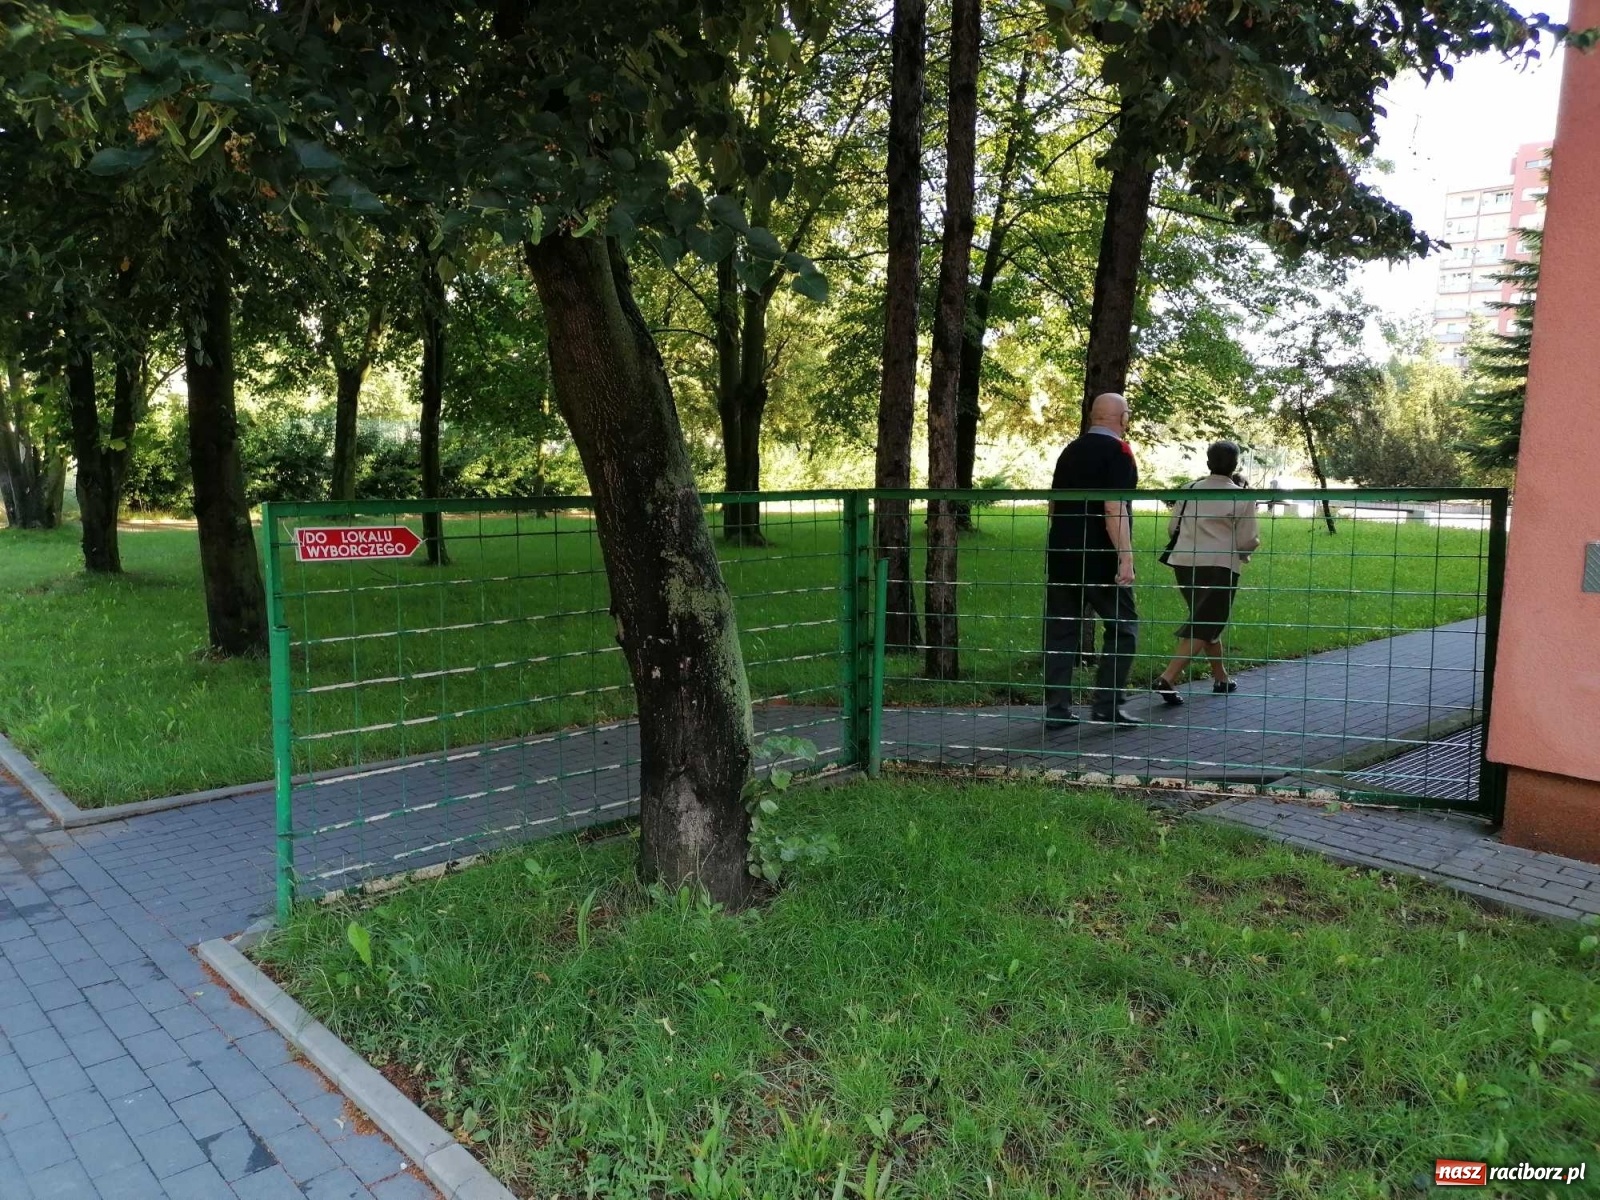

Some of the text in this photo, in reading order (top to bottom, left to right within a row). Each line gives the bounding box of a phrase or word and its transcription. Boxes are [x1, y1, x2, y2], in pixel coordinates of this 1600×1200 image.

[305, 530, 393, 544] DO LOKALU
[306, 542, 406, 558] WYBORCZEGO
